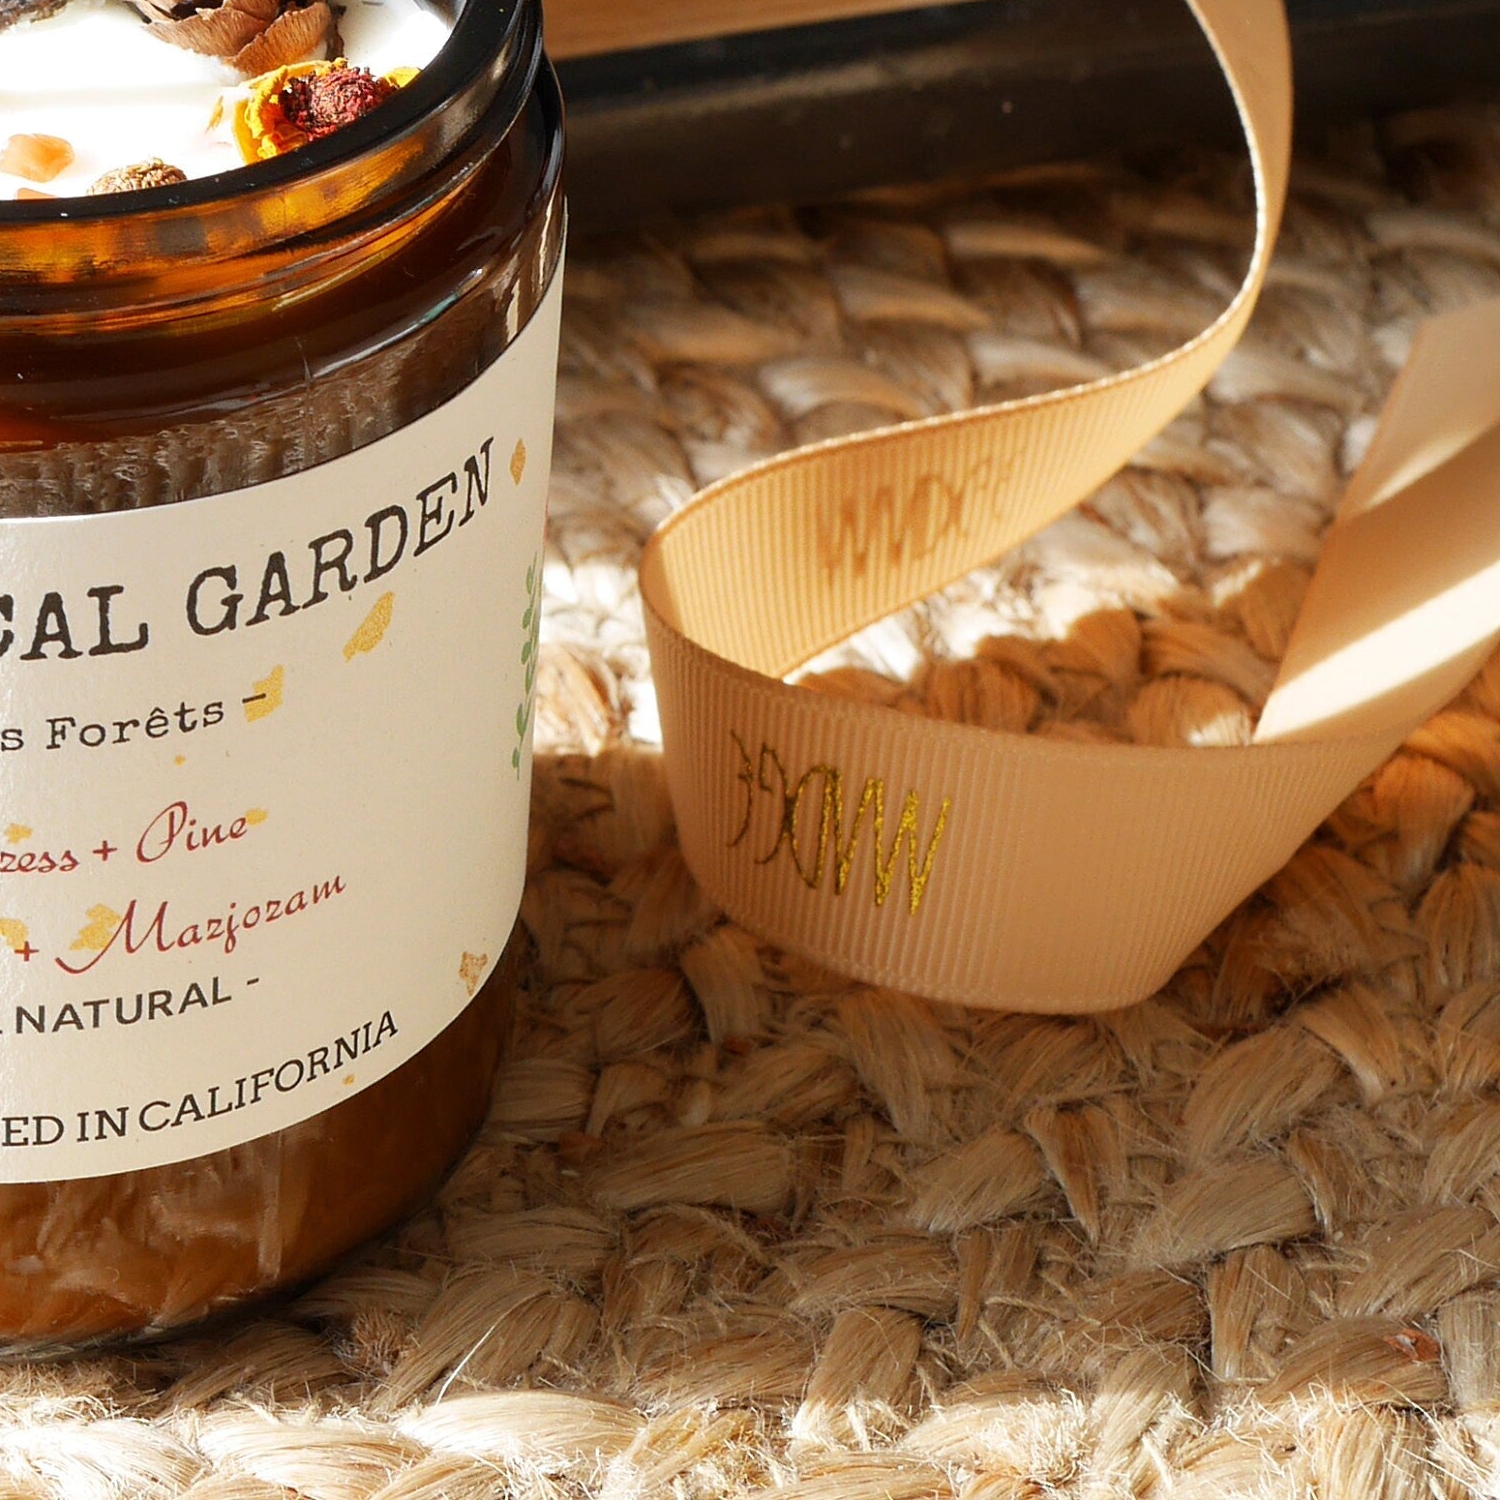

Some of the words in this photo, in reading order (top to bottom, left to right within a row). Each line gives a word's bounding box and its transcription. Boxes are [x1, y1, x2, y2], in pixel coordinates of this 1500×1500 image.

[186, 436, 494, 637] GARDEN
[46, 699, 225, 751] Forêts
[136, 800, 248, 863] Pine
[54, 875, 347, 975] Marjoram
[15, 976, 233, 1035] NATURAL
[76, 1106, 130, 1142] IN
[139, 1009, 400, 1132] CALIFORNIA
